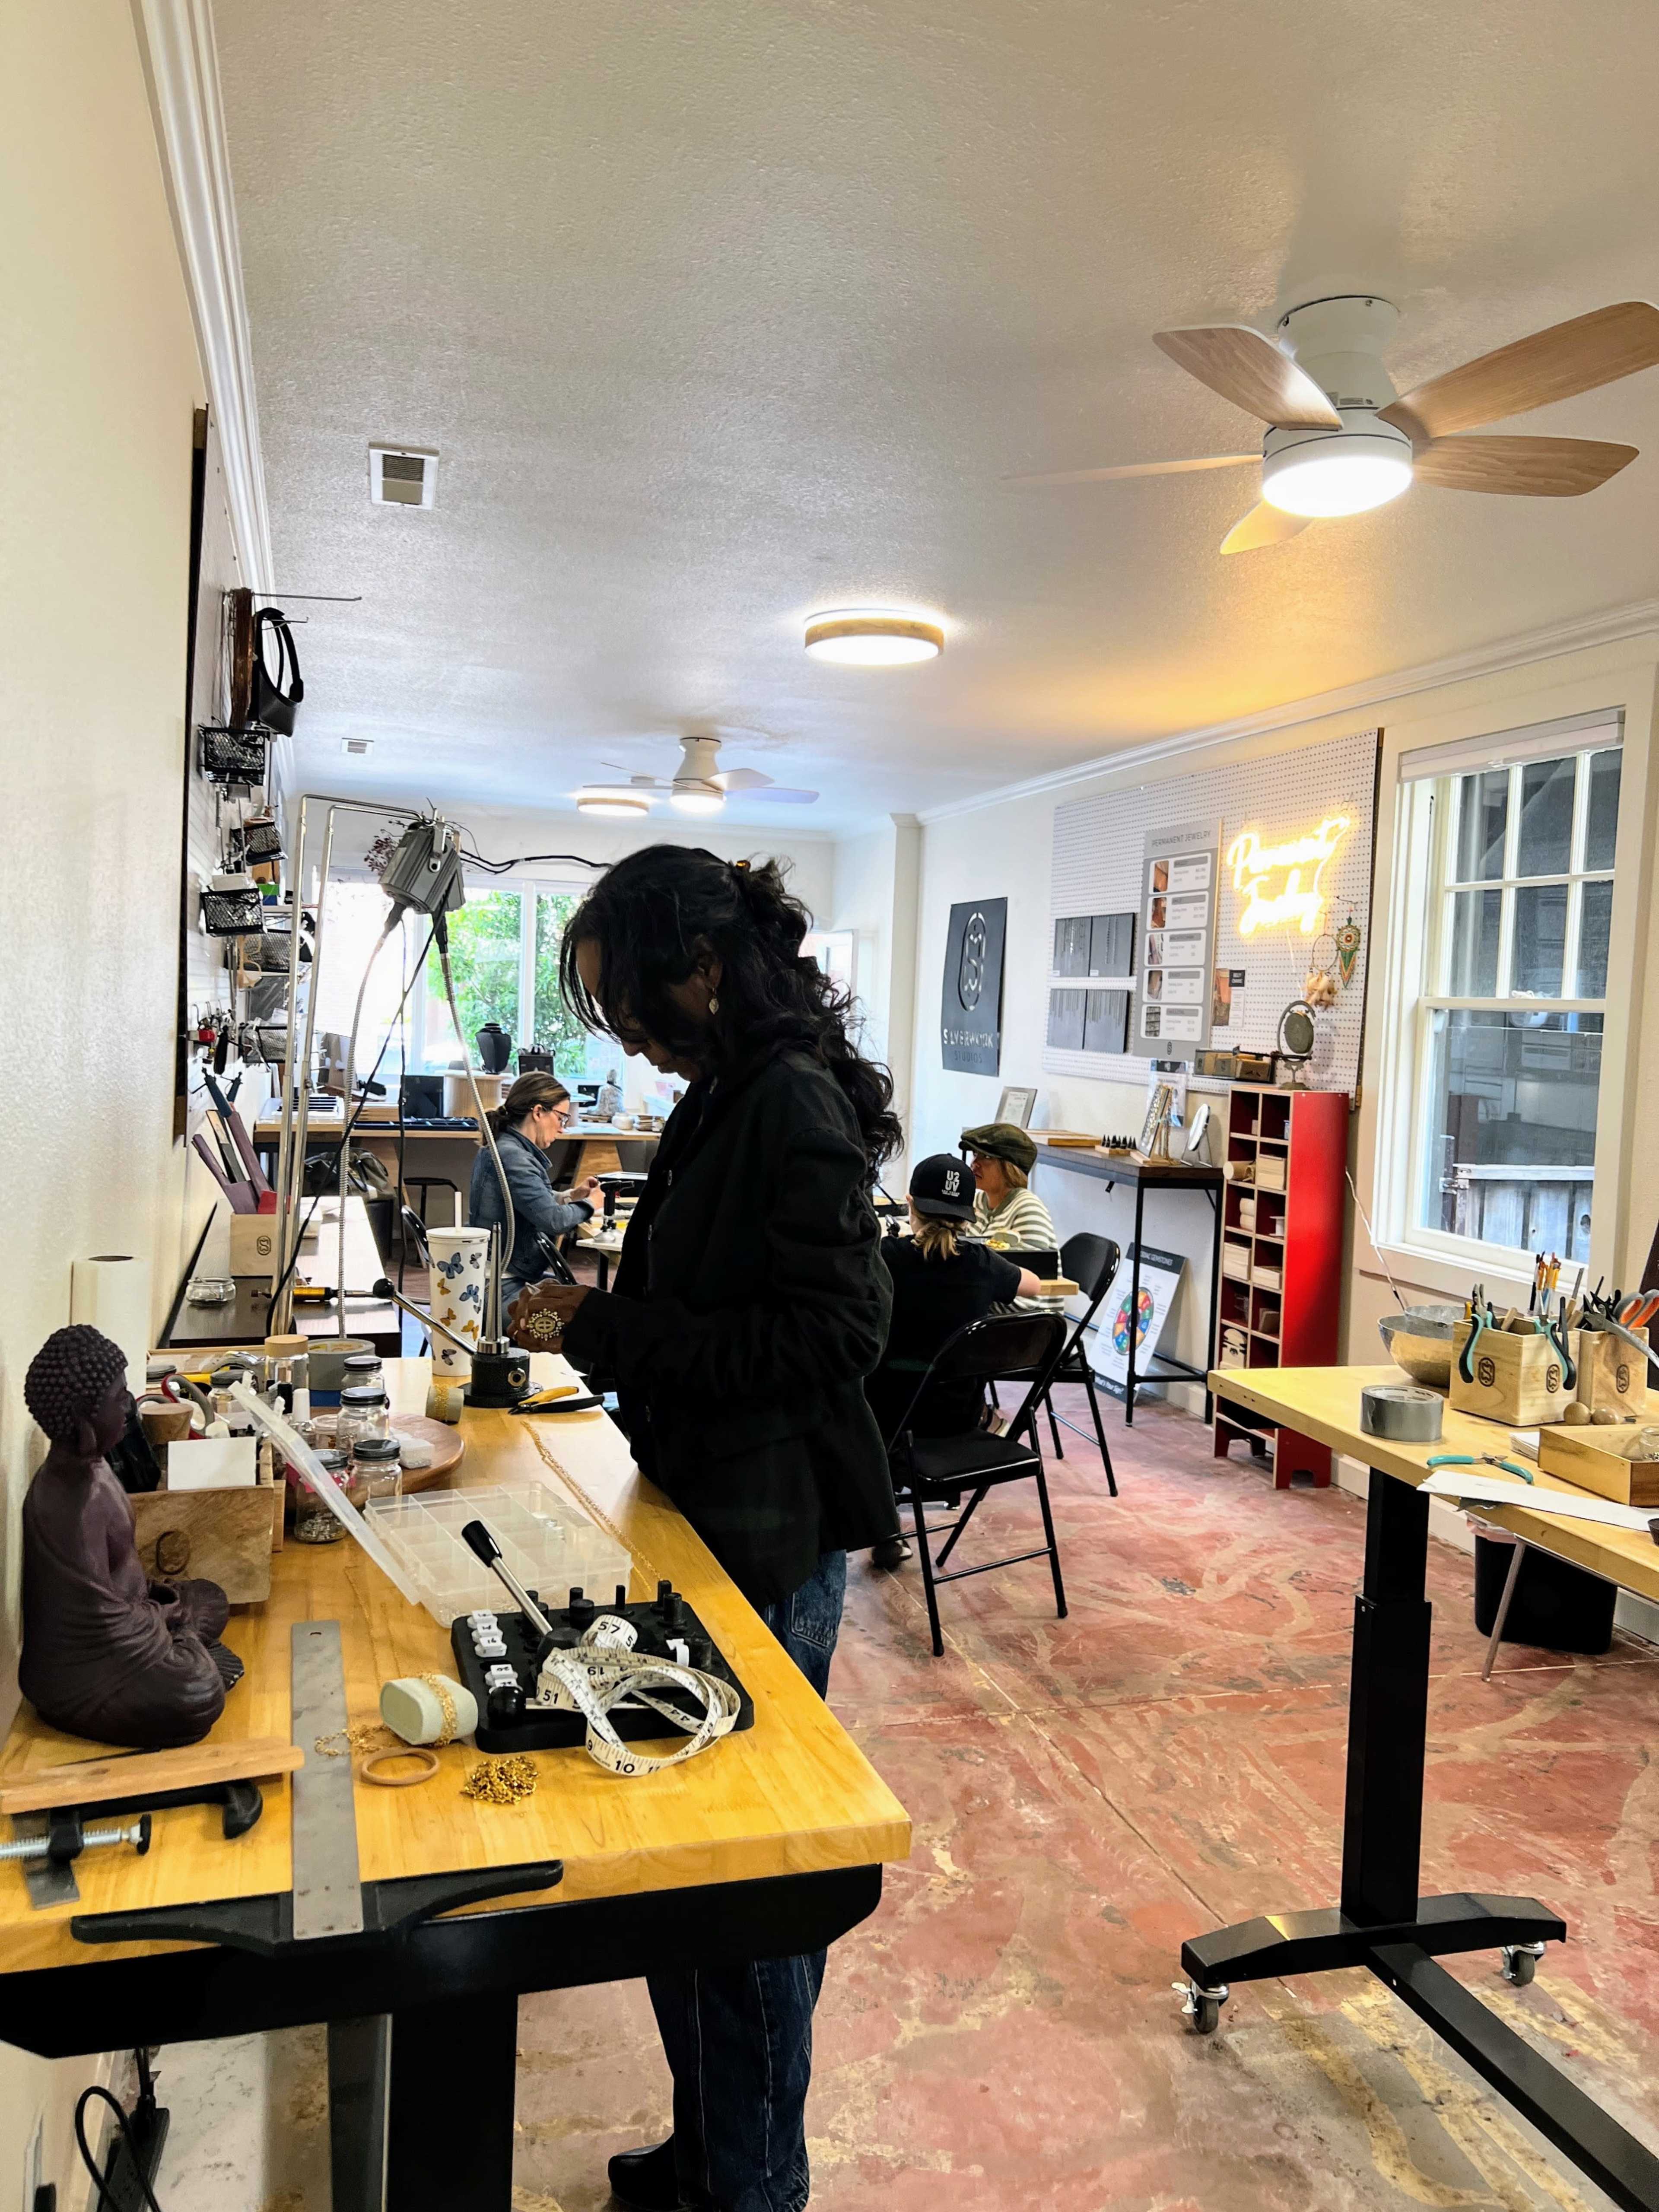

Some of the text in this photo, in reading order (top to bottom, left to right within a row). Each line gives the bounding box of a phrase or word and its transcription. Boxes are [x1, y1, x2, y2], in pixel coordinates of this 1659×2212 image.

[943, 1028, 993, 1048] SLVERWORK
[954, 1050, 983, 1063] STUDIOS
[947, 1170, 960, 1182] U2
[945, 1180, 960, 1192] UV
[597, 1621, 621, 1634] 57
[626, 1635, 636, 1649] 5
[587, 1666, 605, 1675] 19
[543, 1689, 559, 1704] 51
[587, 1739, 593, 1751] 9
[615, 1760, 635, 1773] 10
